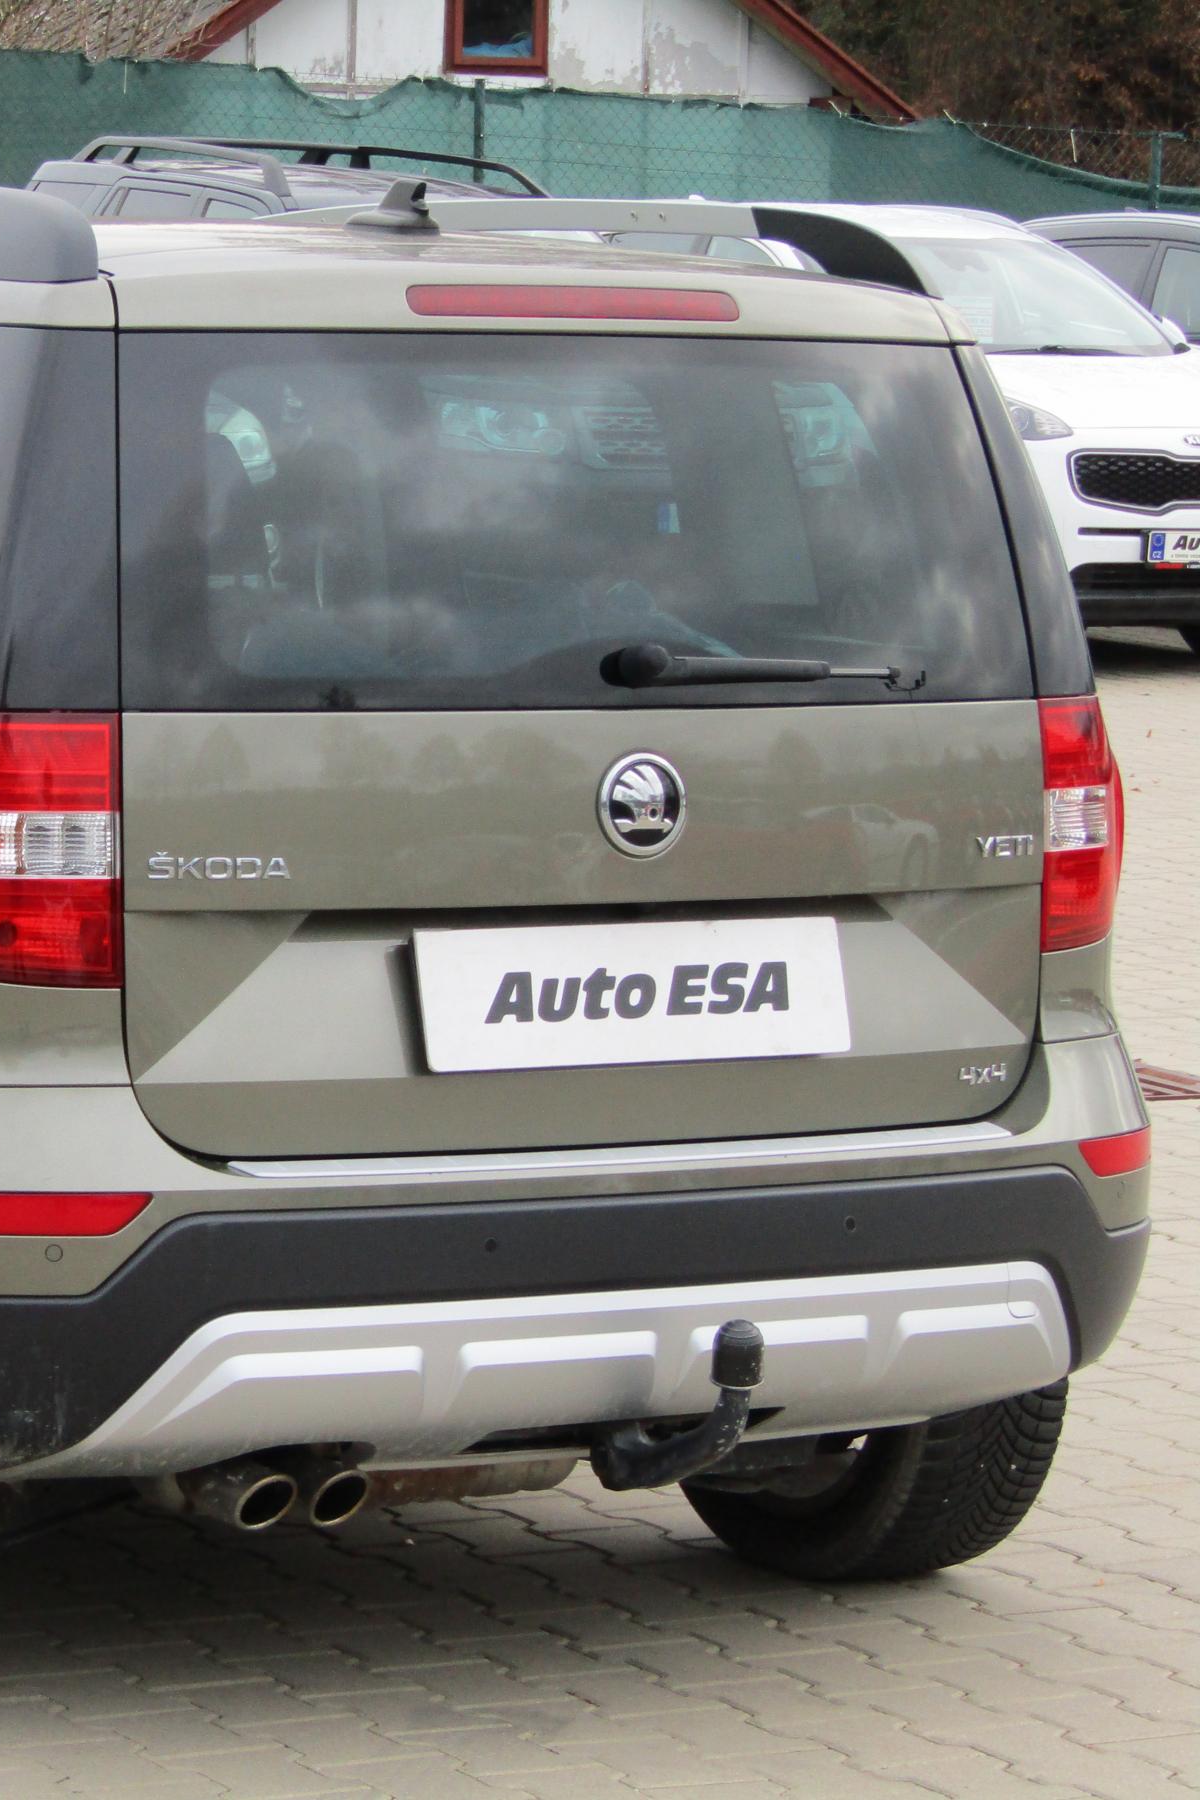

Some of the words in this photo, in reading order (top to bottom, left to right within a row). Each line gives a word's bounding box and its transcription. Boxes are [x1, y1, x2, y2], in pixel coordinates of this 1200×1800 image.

[976, 834, 1033, 858] YETI
[147, 851, 292, 880] ŠKODA
[484, 967, 657, 1023] Auto
[666, 961, 789, 1016] ESA
